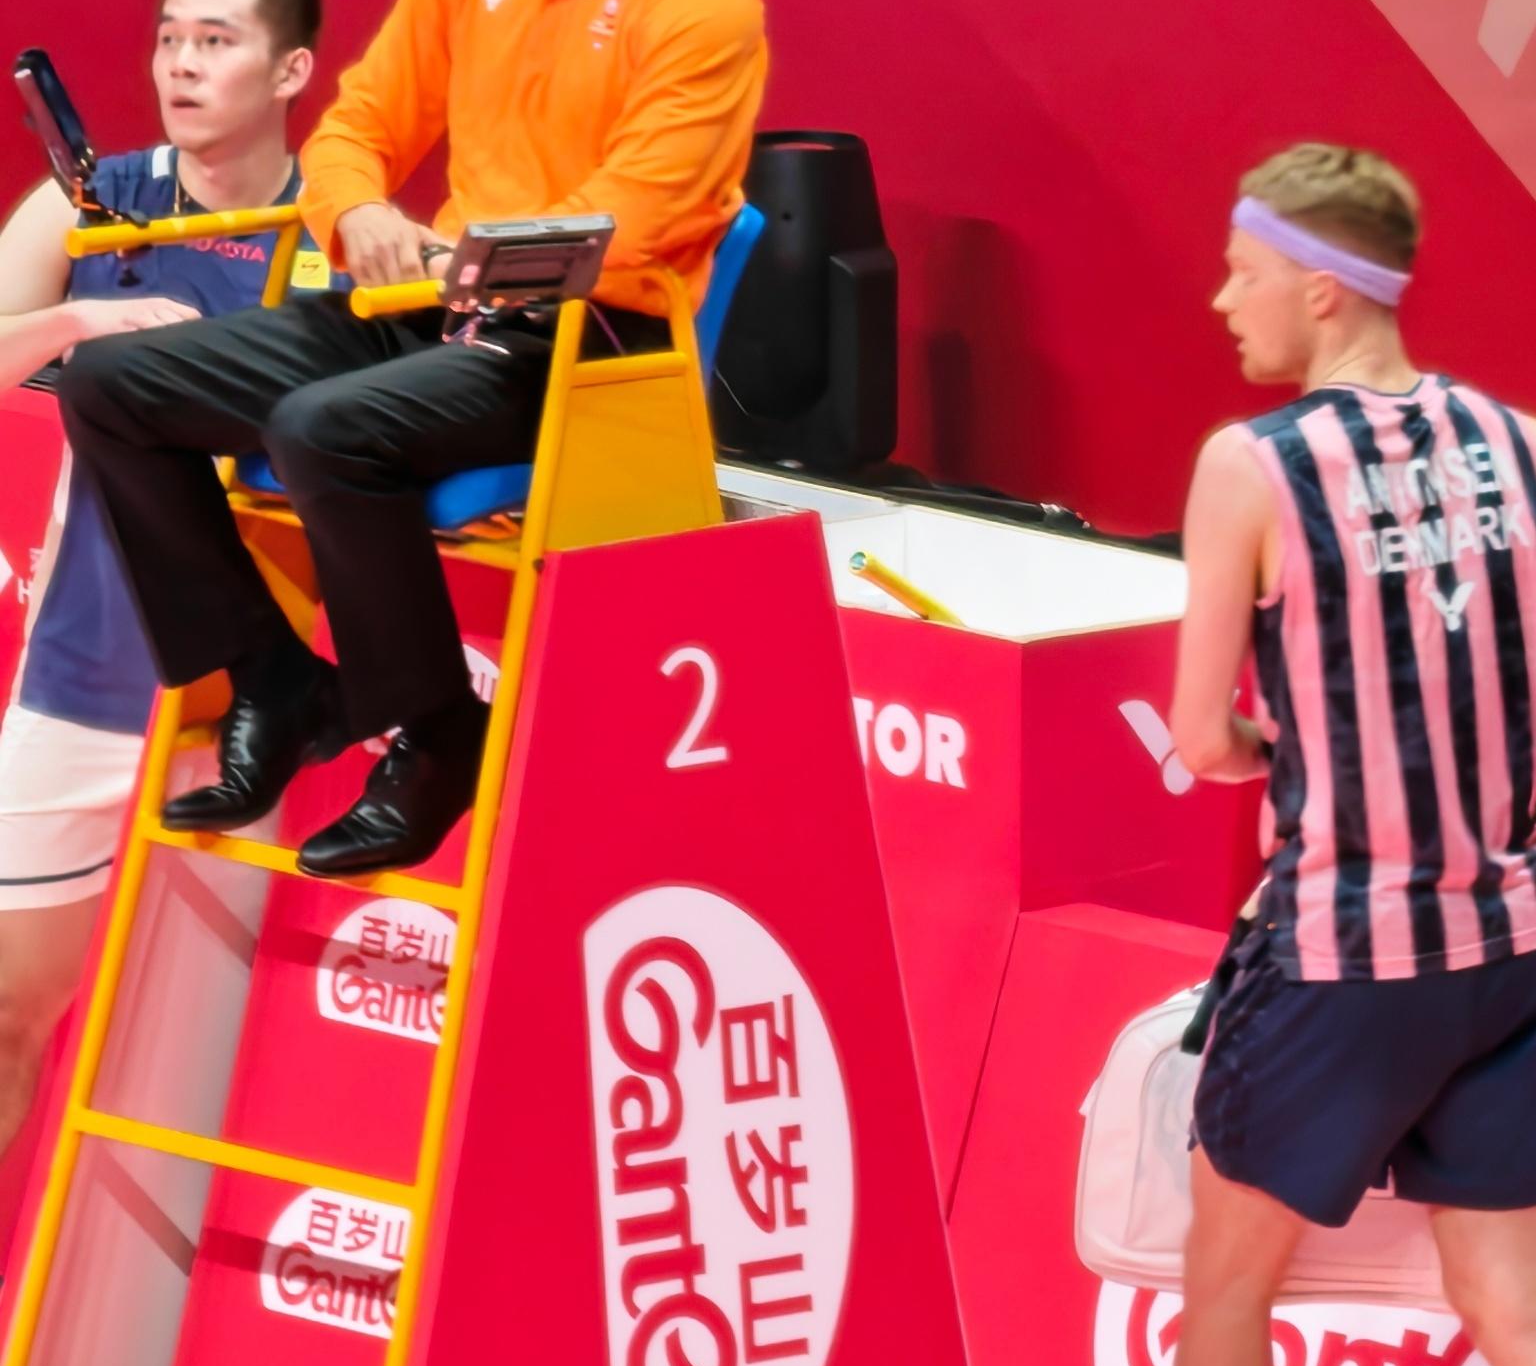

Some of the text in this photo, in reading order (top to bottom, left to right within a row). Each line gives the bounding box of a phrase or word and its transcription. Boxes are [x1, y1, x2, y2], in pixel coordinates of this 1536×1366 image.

[1356, 503, 1532, 577] DENMARK
[659, 646, 728, 770] 2
[719, 994, 814, 1365] 百岁山
